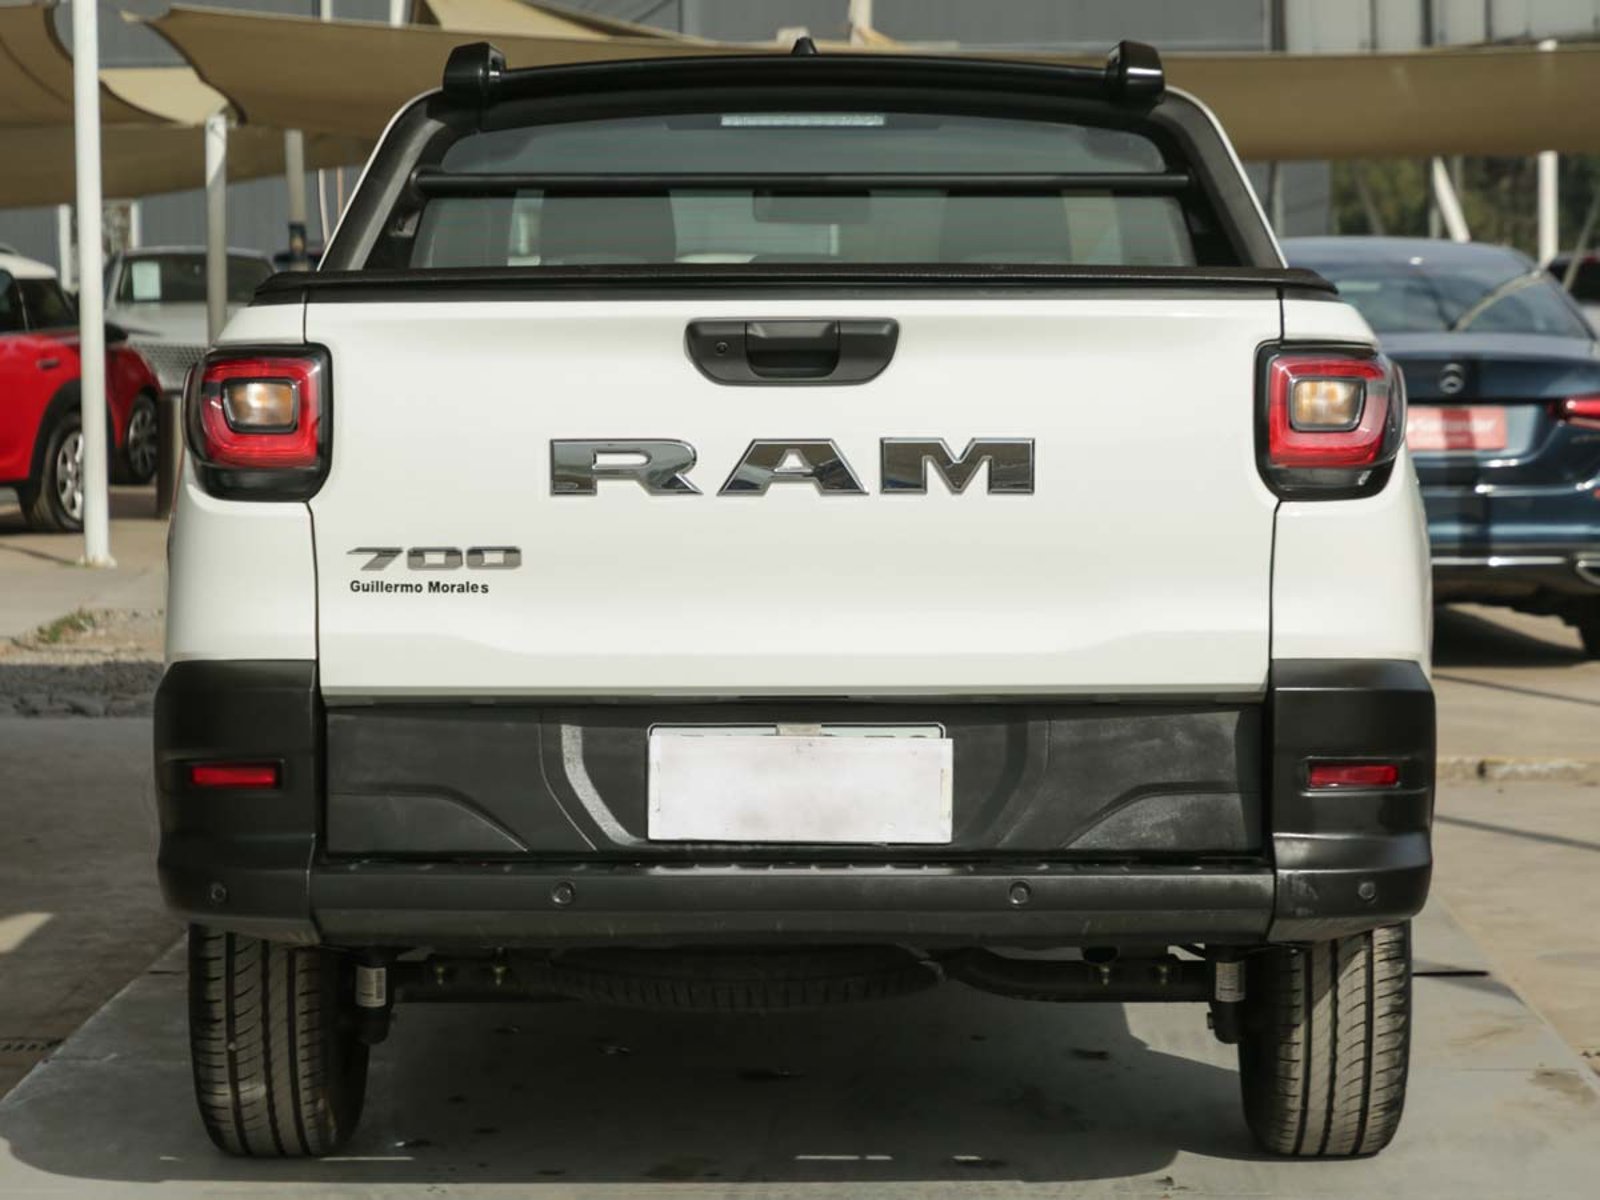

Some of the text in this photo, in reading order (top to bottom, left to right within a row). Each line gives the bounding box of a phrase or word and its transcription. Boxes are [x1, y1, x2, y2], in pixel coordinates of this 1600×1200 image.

[550, 437, 1036, 496] RAM
[347, 546, 522, 571] 700
[350, 580, 489, 593] Guillermo Morales
